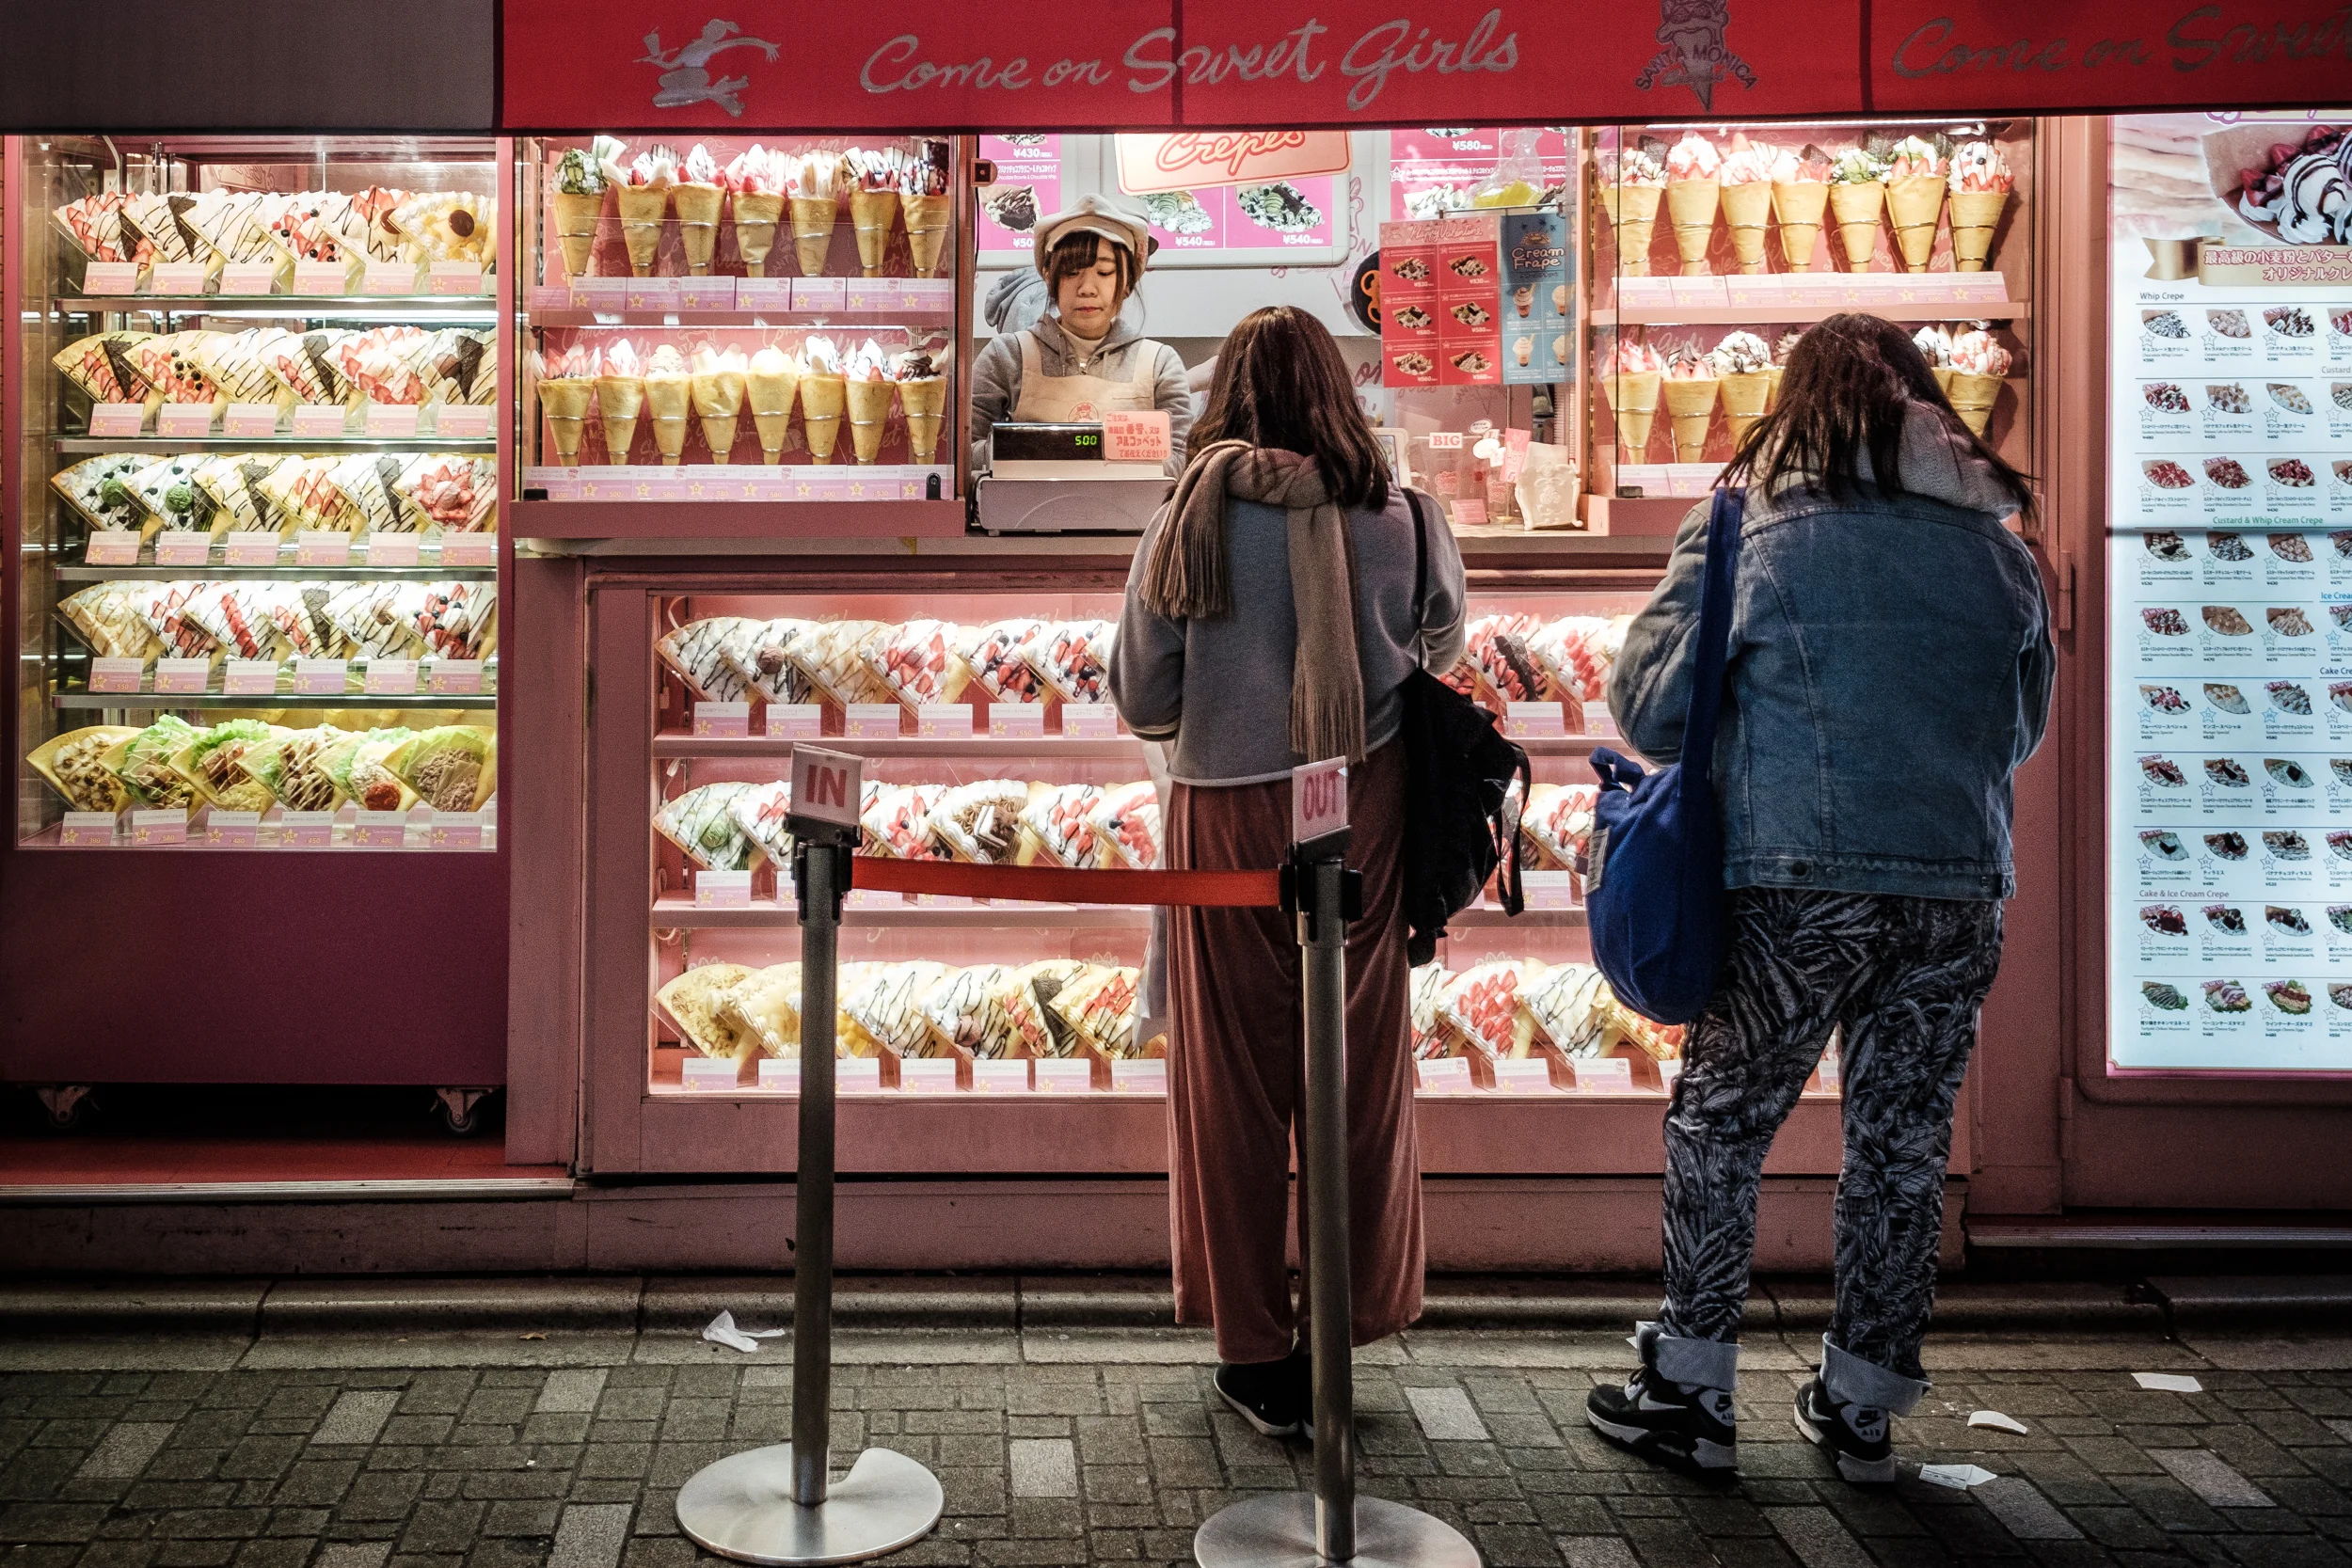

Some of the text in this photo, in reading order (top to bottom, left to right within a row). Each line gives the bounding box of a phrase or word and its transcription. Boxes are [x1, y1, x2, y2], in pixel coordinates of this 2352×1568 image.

[1892, 17, 2070, 79] Come
[2083, 37, 2154, 69] on
[859, 8, 1521, 112] Come on Sweet Girls
[1633, 44, 1758, 91] SANTA MONICA
[1453, 140, 1480, 150] ¥580
[1013, 148, 1041, 158] ¥430
[1283, 234, 1311, 245] ¥540
[1410, 225, 1439, 243] Happy
[1013, 238, 1035, 248] ¥50
[1176, 236, 1202, 246] ¥540
[1511, 247, 1565, 260] Cream
[1513, 258, 1561, 271] Frape
[2140, 292, 2185, 302] Whip Crepe
[1073, 434, 1099, 447] 500
[1432, 435, 1461, 446] BIG
[2251, 516, 2272, 526] Whip
[2300, 516, 2324, 526] Crepe
[2319, 667, 2339, 675] Cake
[805, 764, 847, 808] IN
[1302, 770, 1340, 821] OUT
[2139, 889, 2158, 897] Cake
[2207, 890, 2230, 898] Crepe
